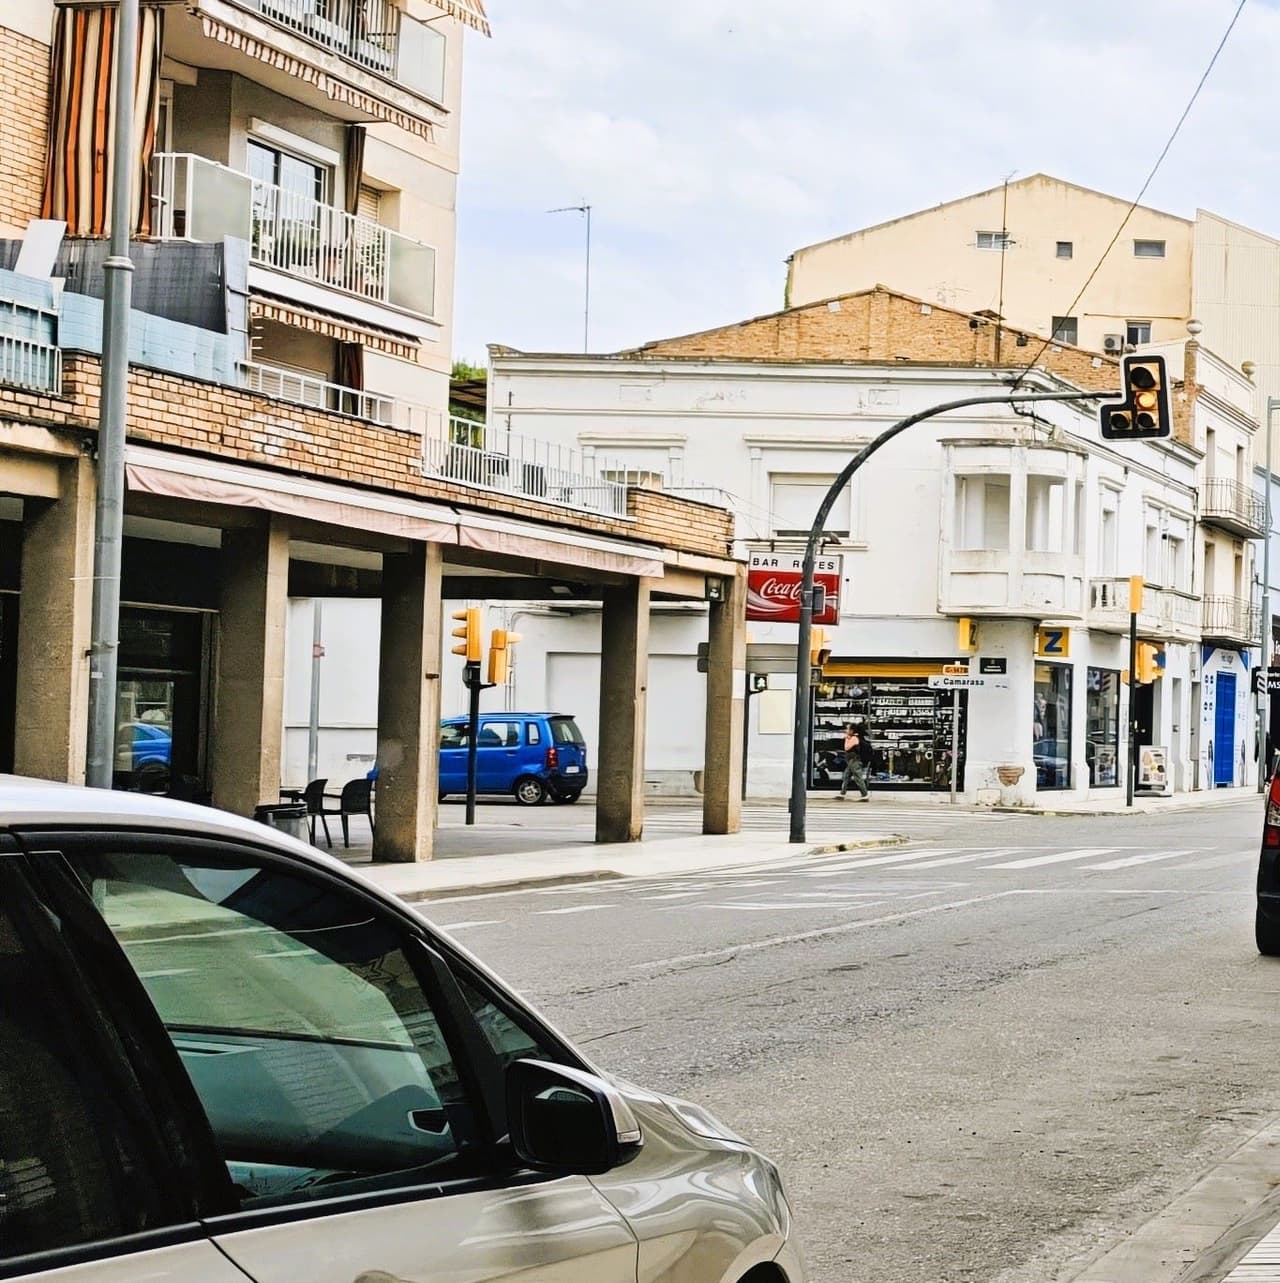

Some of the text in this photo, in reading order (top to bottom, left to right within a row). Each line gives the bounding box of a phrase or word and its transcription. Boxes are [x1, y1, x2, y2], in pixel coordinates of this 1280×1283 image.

[752, 557, 835, 570] BAR RES
[1044, 631, 1063, 652] Z
[943, 678, 985, 686] Camarasa
